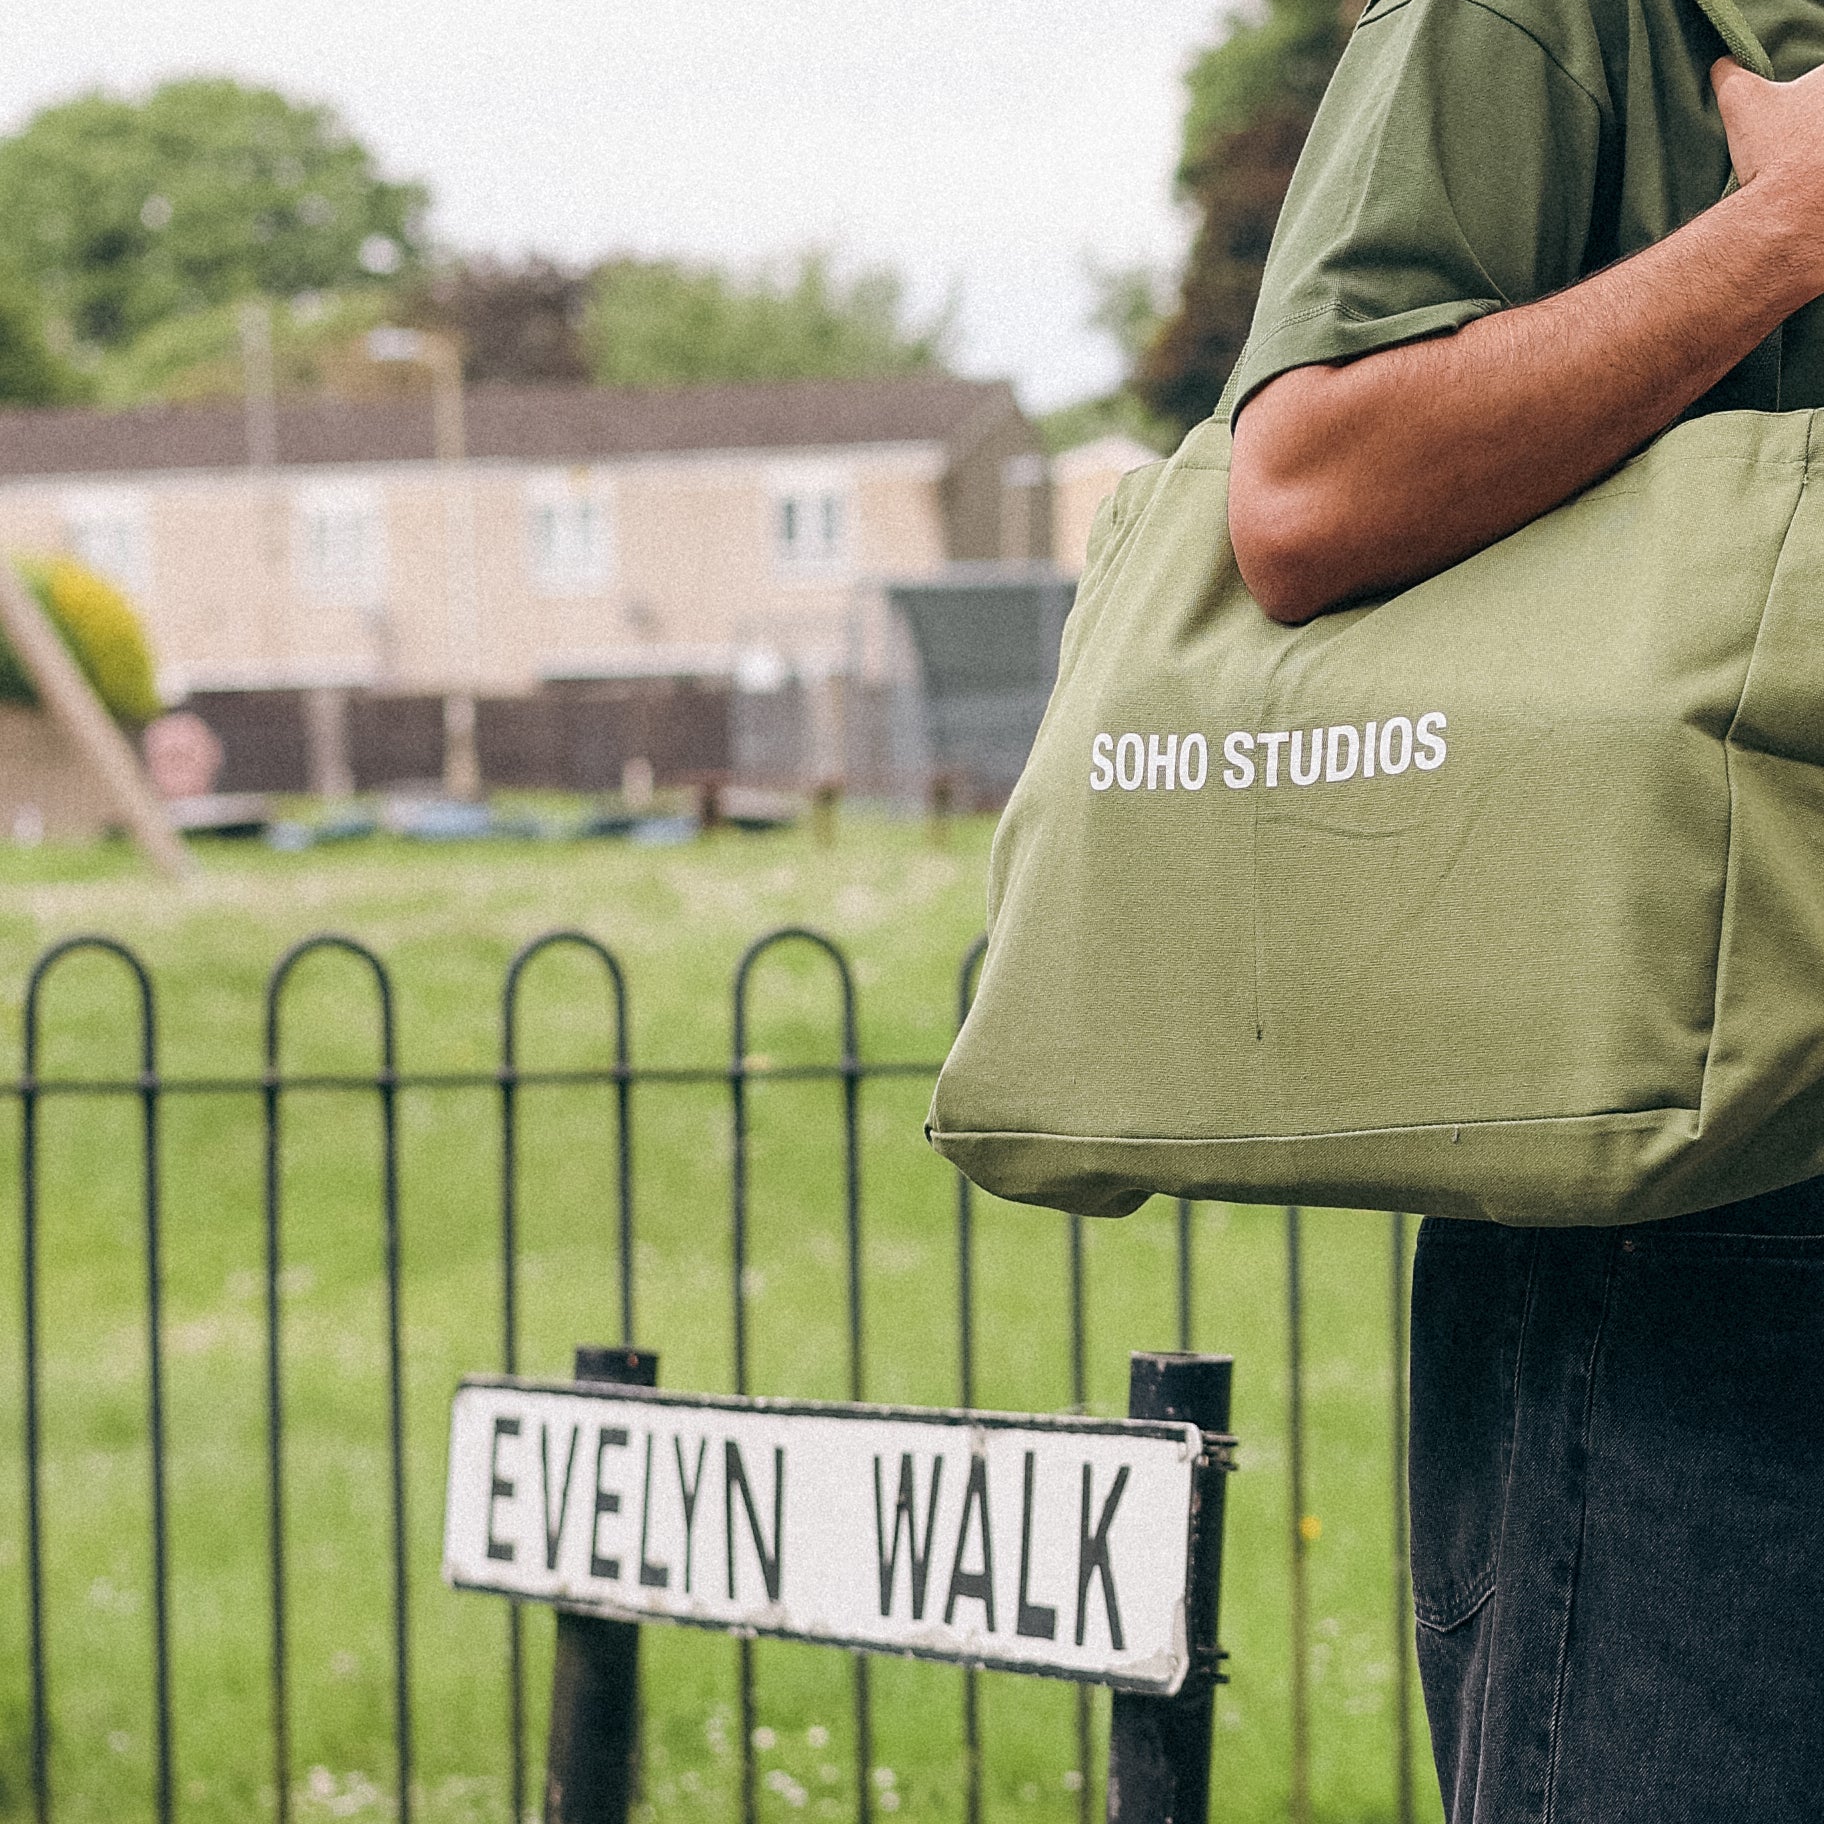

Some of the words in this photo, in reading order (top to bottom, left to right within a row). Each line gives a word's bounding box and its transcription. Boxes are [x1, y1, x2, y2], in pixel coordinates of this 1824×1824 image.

[1089, 732, 1208, 791] SOHO
[1223, 711, 1448, 789] STUDIOS
[487, 1416, 785, 1603] EVELYN
[873, 1450, 1131, 1652] WALK
